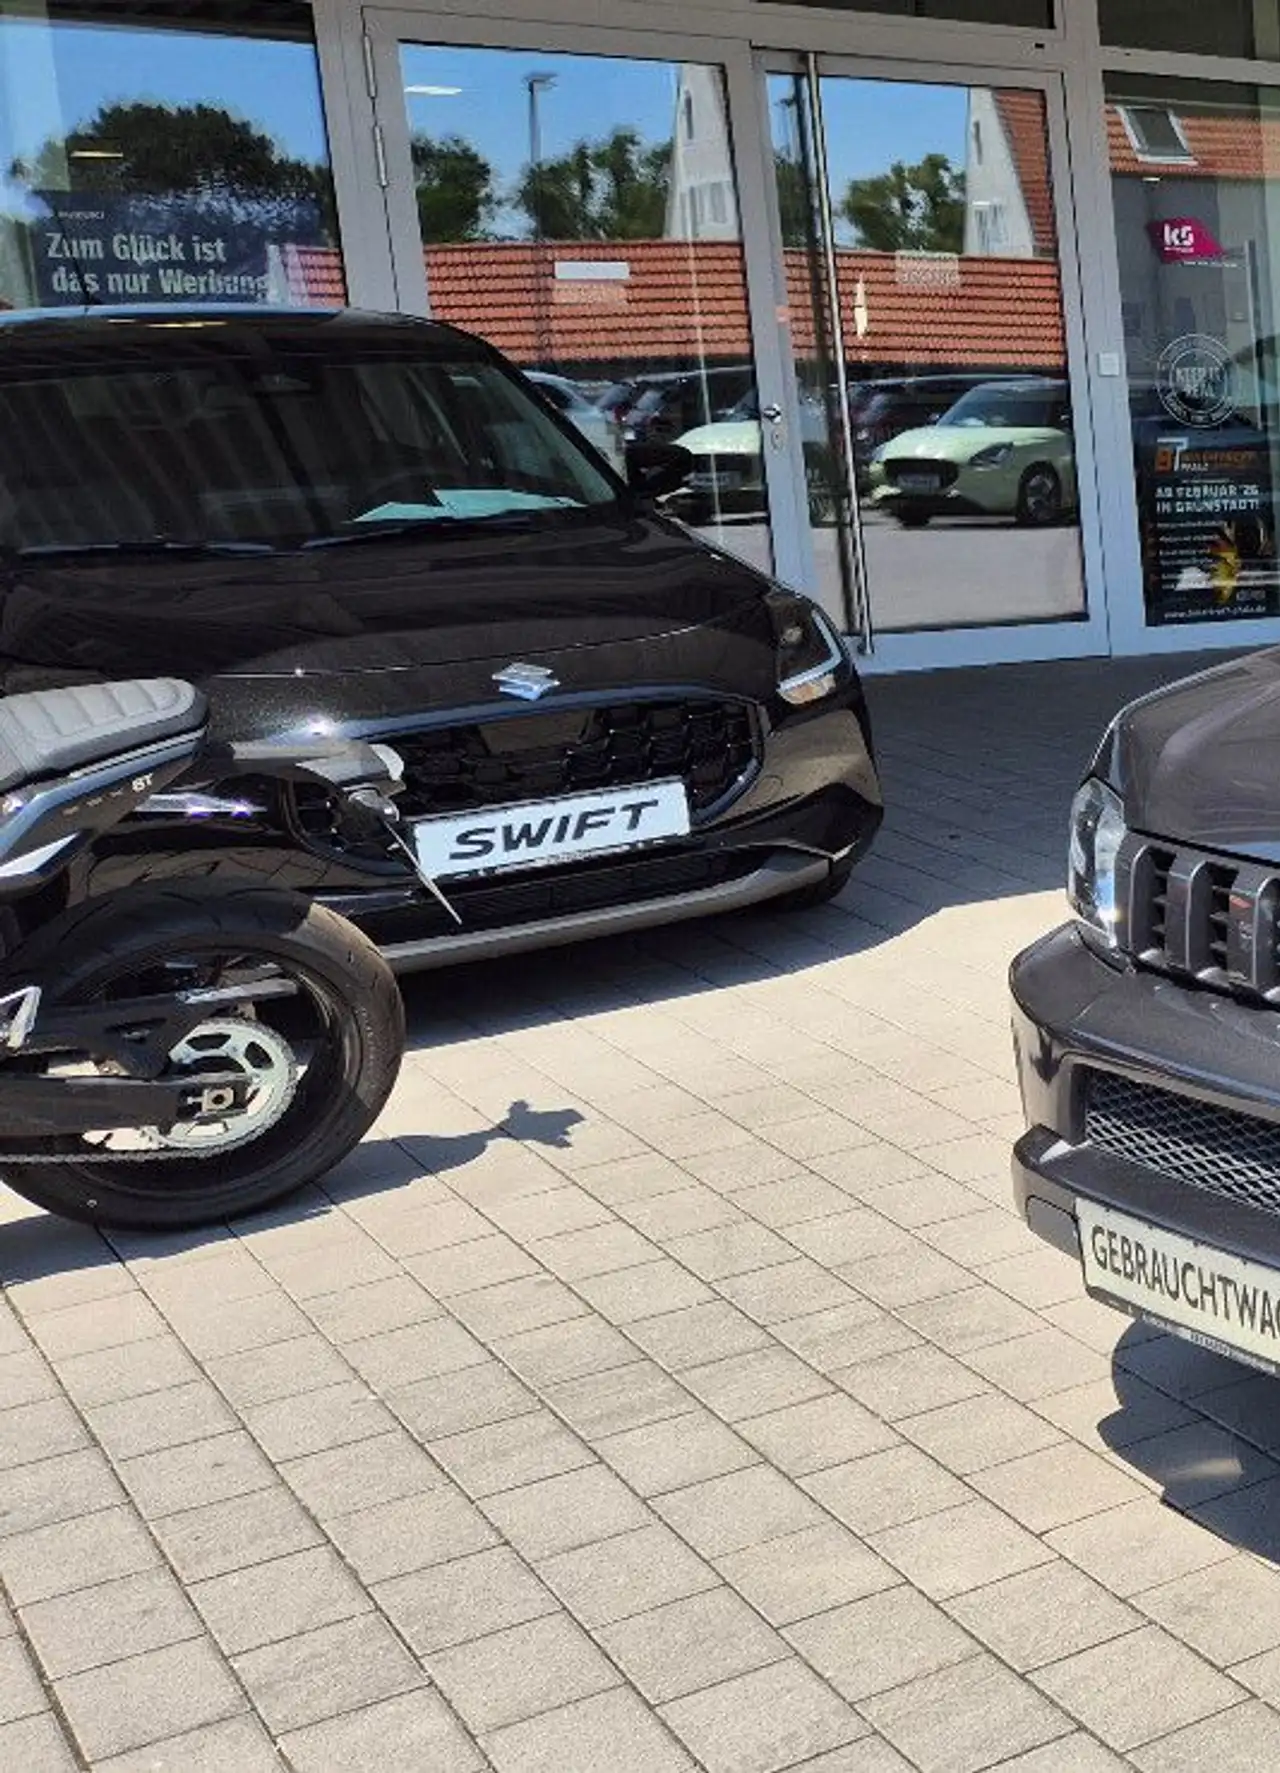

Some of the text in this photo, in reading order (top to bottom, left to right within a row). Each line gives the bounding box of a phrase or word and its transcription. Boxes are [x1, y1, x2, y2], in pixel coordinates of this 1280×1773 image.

[46, 233, 226, 263] Zum Glück ist
[52, 266, 268, 300] das nur Werbung
[1175, 484, 1237, 498] FEBRUAR
[449, 799, 659, 861] SWIFT
